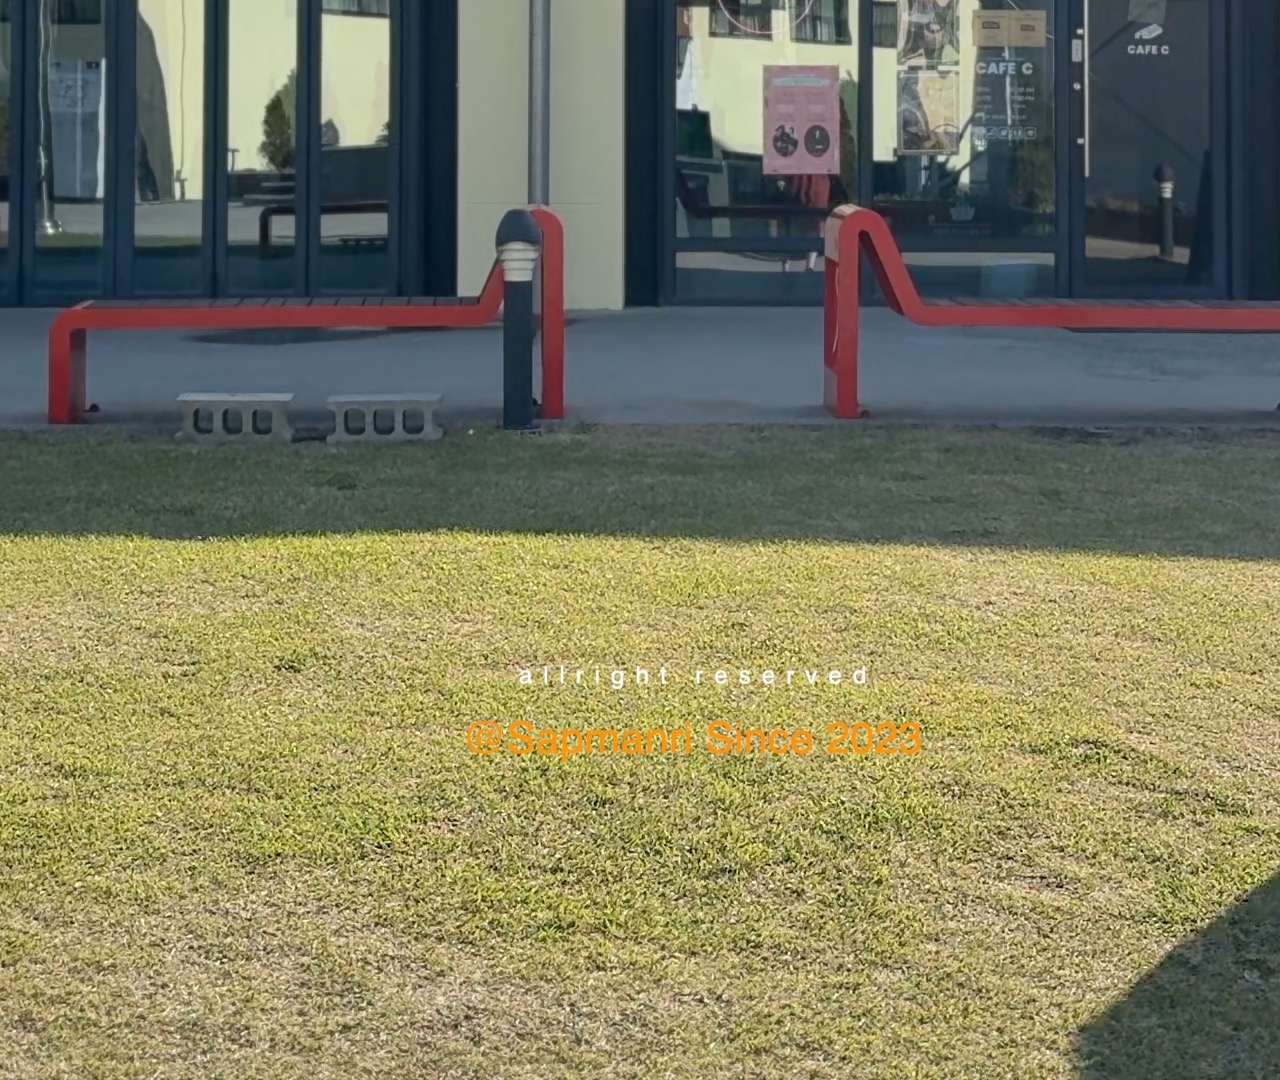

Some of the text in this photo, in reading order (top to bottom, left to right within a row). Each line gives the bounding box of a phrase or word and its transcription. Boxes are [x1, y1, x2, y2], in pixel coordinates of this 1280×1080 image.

[1127, 45, 1170, 55] CAFE C
[976, 62, 1034, 75] CAFE C
